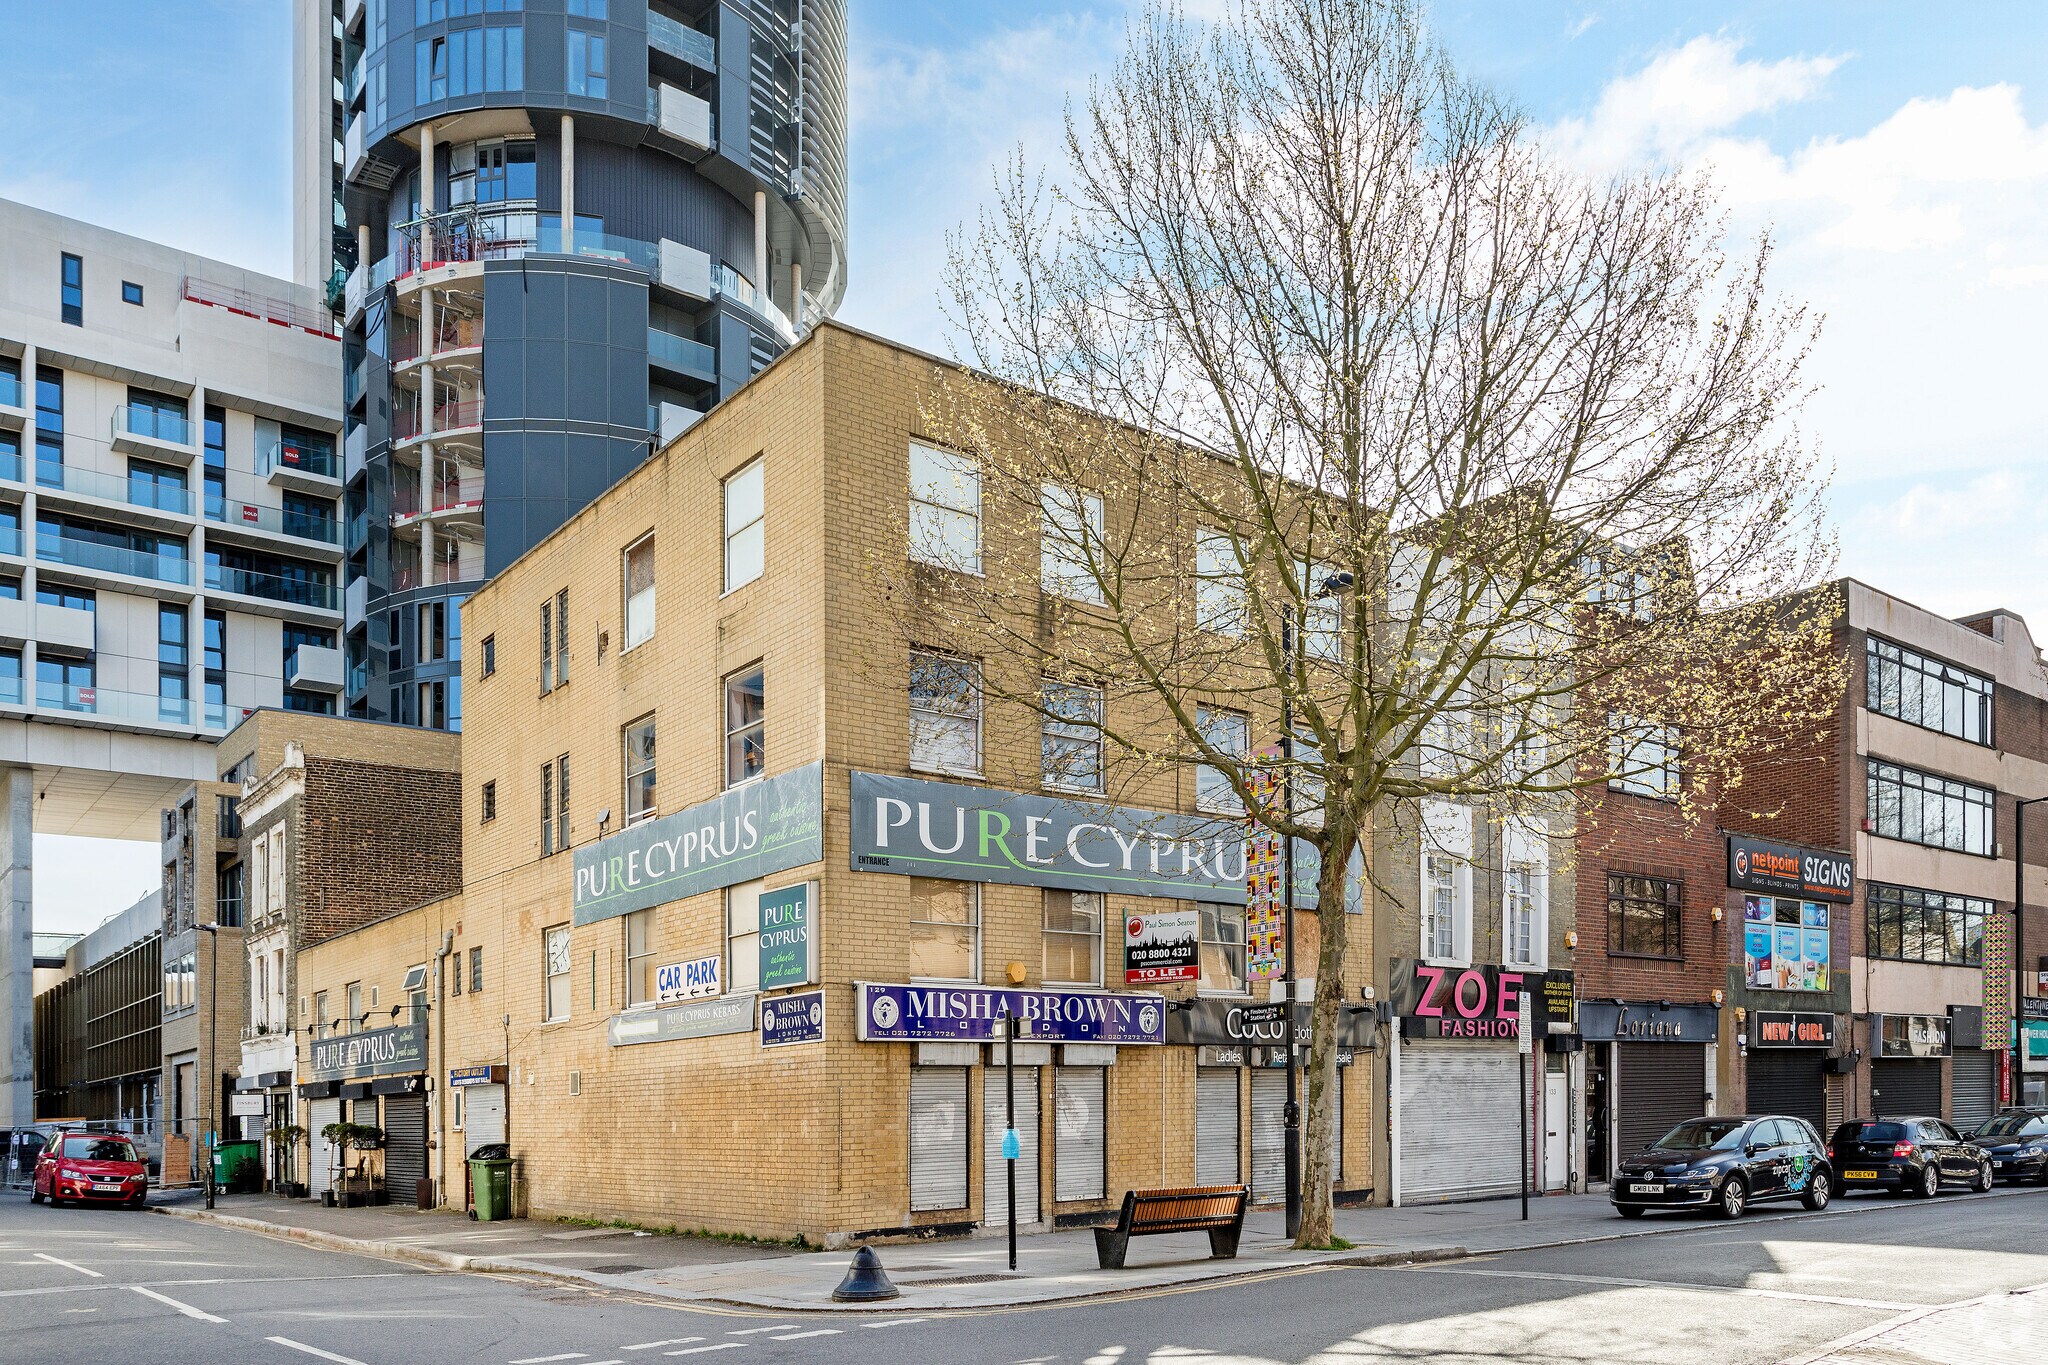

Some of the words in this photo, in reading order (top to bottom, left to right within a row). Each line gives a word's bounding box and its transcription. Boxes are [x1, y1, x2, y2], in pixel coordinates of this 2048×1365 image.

[285, 451, 299, 459] SOLD
[243, 510, 258, 518] SOLD
[79, 692, 96, 700] SOLD
[876, 797, 1054, 867] PURE
[1066, 823, 1247, 882] CYPRU
[577, 849, 641, 902] PURE
[645, 810, 758, 878] CYPRUS
[858, 855, 890, 867] ENTRANCE
[1751, 851, 1799, 877] netpoint
[1804, 856, 1851, 888] SIGNS
[1784, 882, 1799, 890] PRINTS
[764, 902, 802, 926] PURE
[1158, 919, 1176, 928] Simon
[760, 926, 807, 949] CYPRUS
[1131, 950, 1147, 960] 020
[1148, 948, 1170, 959] 8800
[1171, 947, 1191, 957] 4321
[659, 966, 681, 991] CAR
[686, 959, 717, 987] PARK
[1138, 969, 1157, 978] TO
[1160, 967, 1185, 977] LET
[1415, 965, 1524, 1019] ZOE
[1545, 981, 1571, 990] EXCLUSIVE
[666, 1011, 685, 1025] PURE
[685, 1008, 711, 1023] CYPRUS
[713, 1004, 741, 1018] KEBABS
[777, 1000, 806, 1015] MISHA
[906, 990, 1012, 1020] MISHA
[1020, 995, 1132, 1024] BROWN
[775, 1013, 809, 1030] BROWN
[1616, 1006, 1682, 1036] Loriana
[777, 1029, 808, 1038] LONDON
[1762, 1022, 1790, 1041] NEW
[1797, 1022, 1825, 1041] GIRL
[1913, 1030, 1946, 1044] FASHION
[317, 1042, 345, 1070] PURE
[347, 1033, 395, 1066] CYPRUS
[1215, 1050, 1241, 1063] Ladies
[1273, 1051, 1287, 1063] Reta
[1772, 1160, 1791, 1177] zipcar
